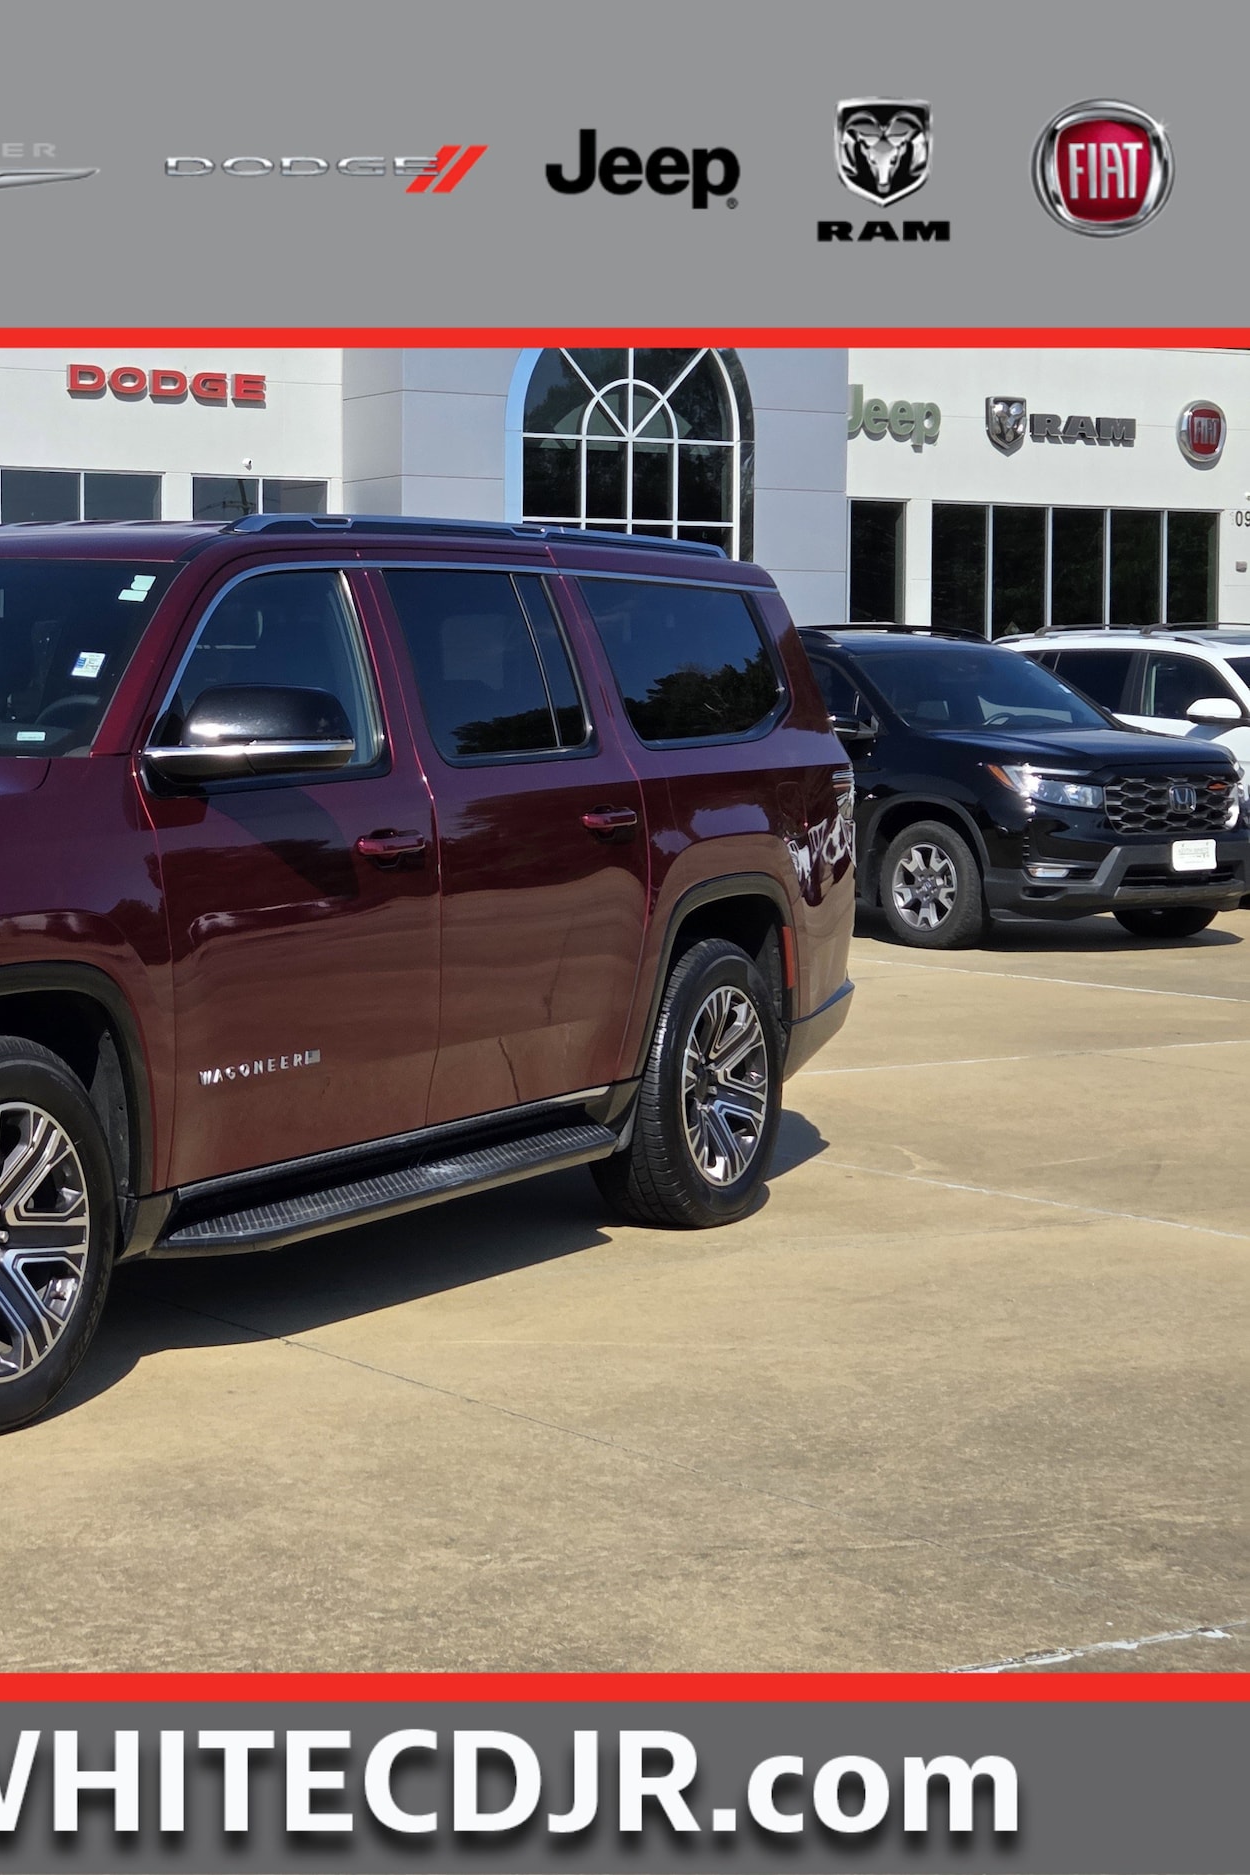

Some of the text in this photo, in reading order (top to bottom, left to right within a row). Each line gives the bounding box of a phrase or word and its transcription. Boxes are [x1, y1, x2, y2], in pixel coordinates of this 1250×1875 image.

[67, 364, 266, 402] DODGE
[1030, 413, 1136, 442] RAM
[199, 1053, 303, 1086] WAGONEER
